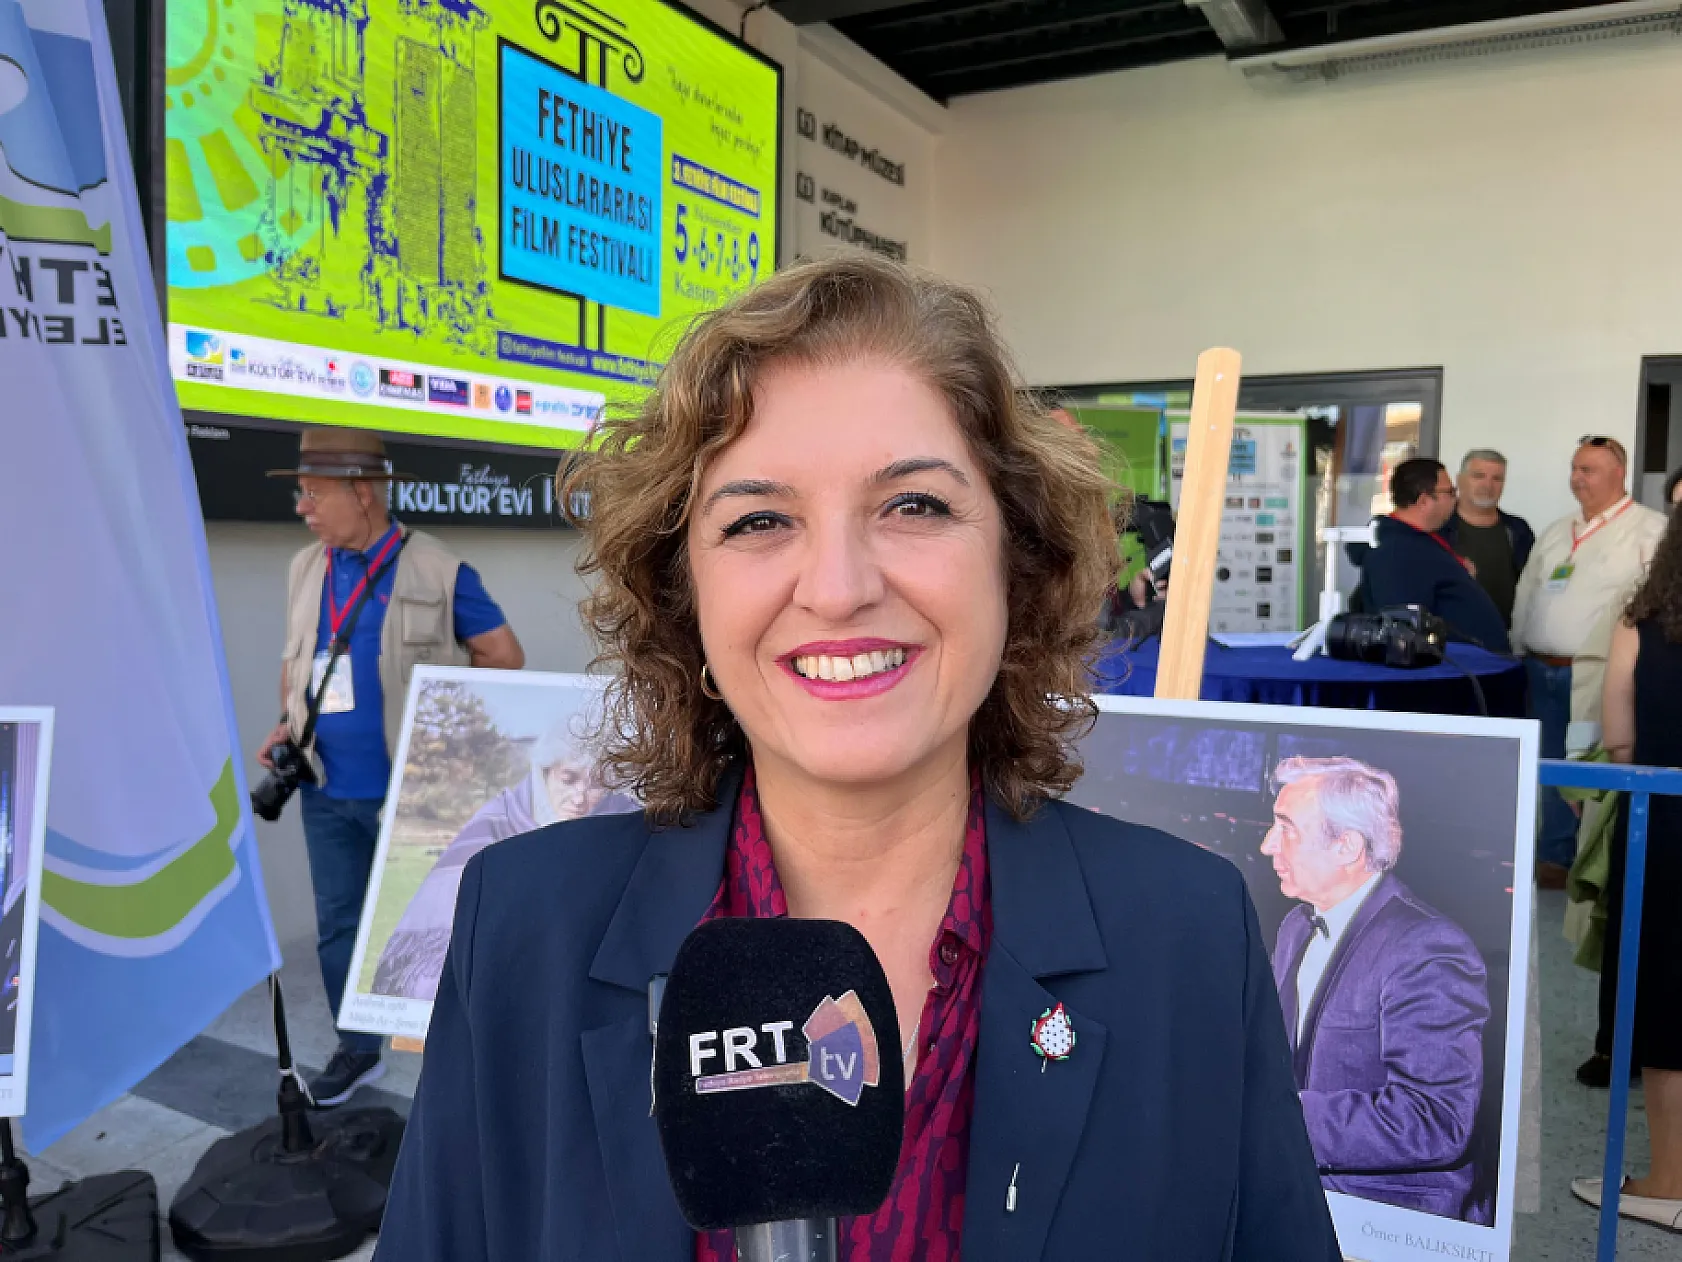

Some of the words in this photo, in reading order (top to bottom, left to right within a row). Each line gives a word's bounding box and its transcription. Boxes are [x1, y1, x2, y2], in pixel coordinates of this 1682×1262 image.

[538, 87, 632, 173] FETHİYE
[512, 146, 652, 233] ULUSLARARASI
[511, 205, 560, 260] FİLM
[568, 223, 653, 283] FESTİVALİ
[688, 1021, 794, 1077] FRT
[820, 1046, 857, 1081] tv
[1361, 1220, 1399, 1244] Ömer
